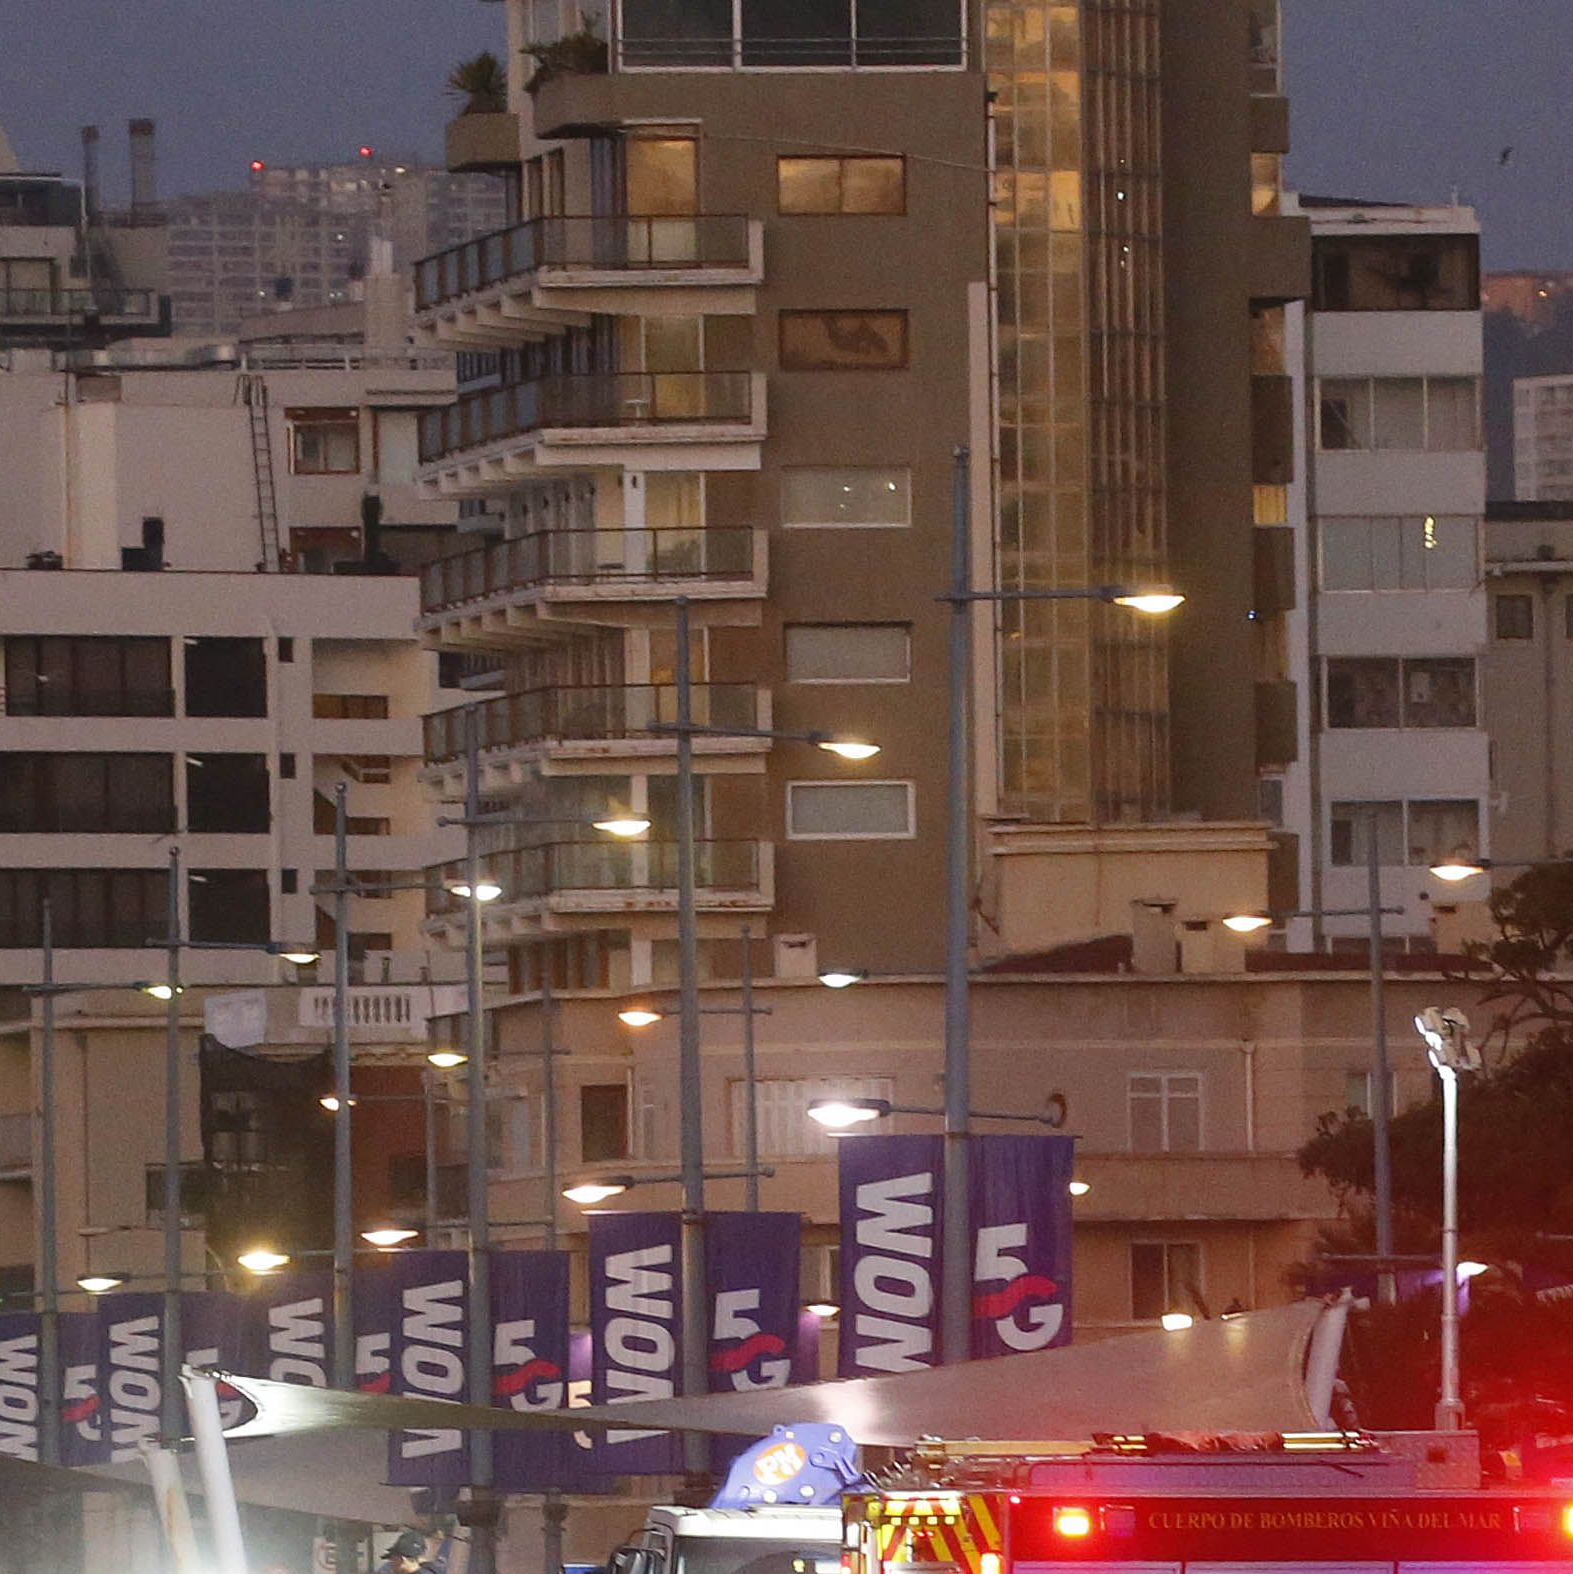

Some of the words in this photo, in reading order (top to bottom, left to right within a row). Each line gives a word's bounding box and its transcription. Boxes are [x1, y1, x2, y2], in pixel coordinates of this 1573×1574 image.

[974, 1223, 1064, 1351] 5G
[494, 1320, 563, 1412] 5G
[713, 1288, 791, 1392] 5G
[755, 1443, 804, 1484] PM
[1148, 1512, 1226, 1529] CUERPO
[1230, 1512, 1254, 1529] DE
[1260, 1512, 1364, 1529] BOMBEROS
[1368, 1508, 1417, 1529] VIÑA
[1418, 1512, 1450, 1529] DEL
[1459, 1512, 1501, 1529] MAR
